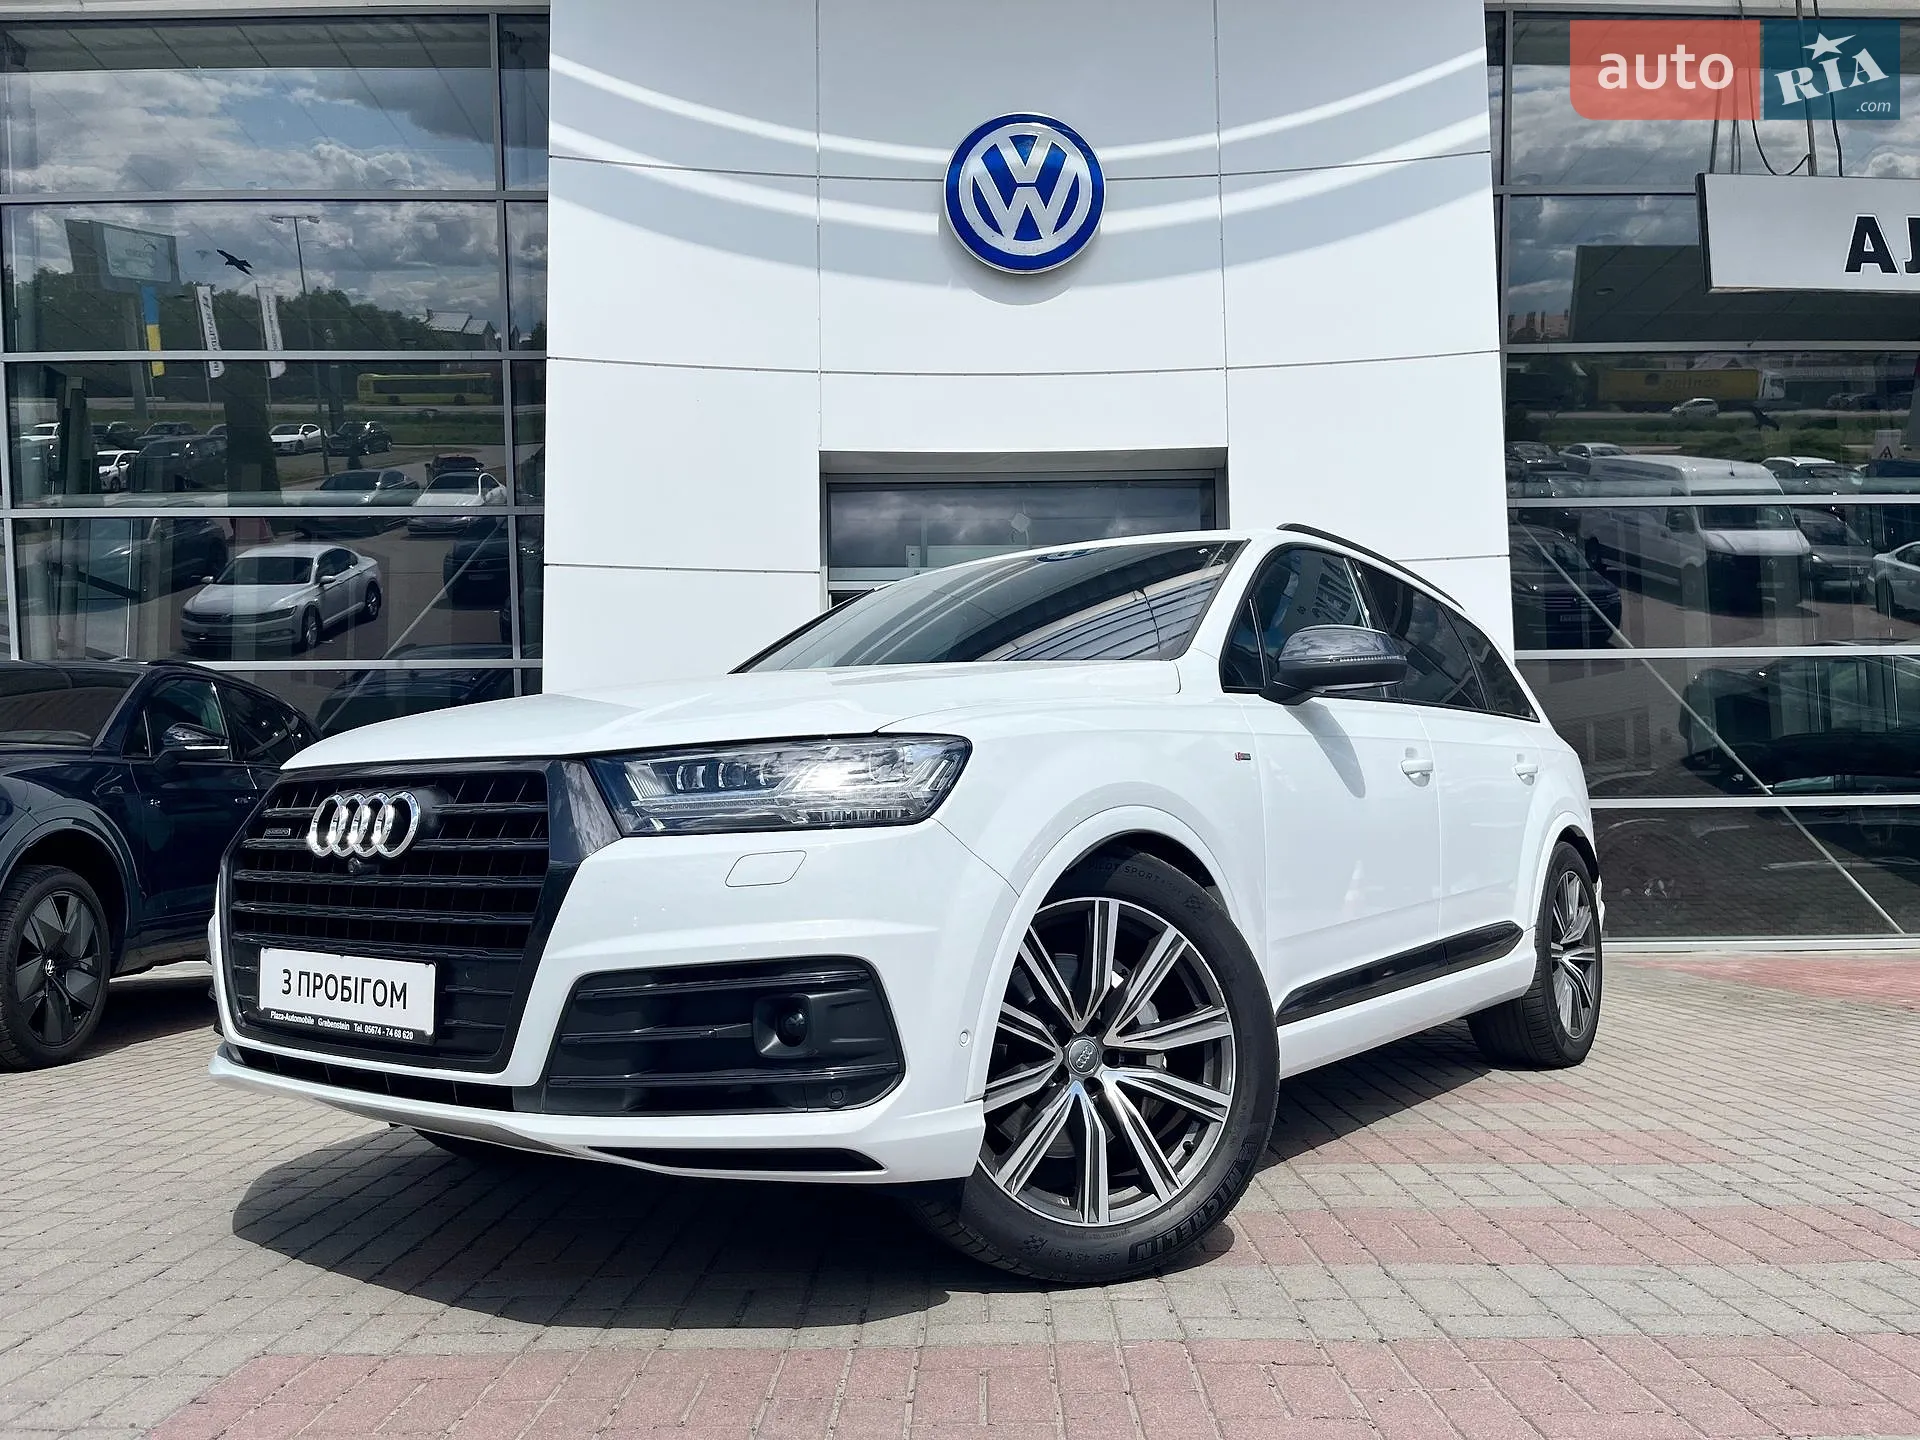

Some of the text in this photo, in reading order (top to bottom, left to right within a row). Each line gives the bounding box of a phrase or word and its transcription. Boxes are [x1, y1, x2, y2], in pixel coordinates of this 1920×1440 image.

[281, 968, 407, 1010] З ПРОБІГОМ
[1137, 1168, 1242, 1260] MICHELIN
